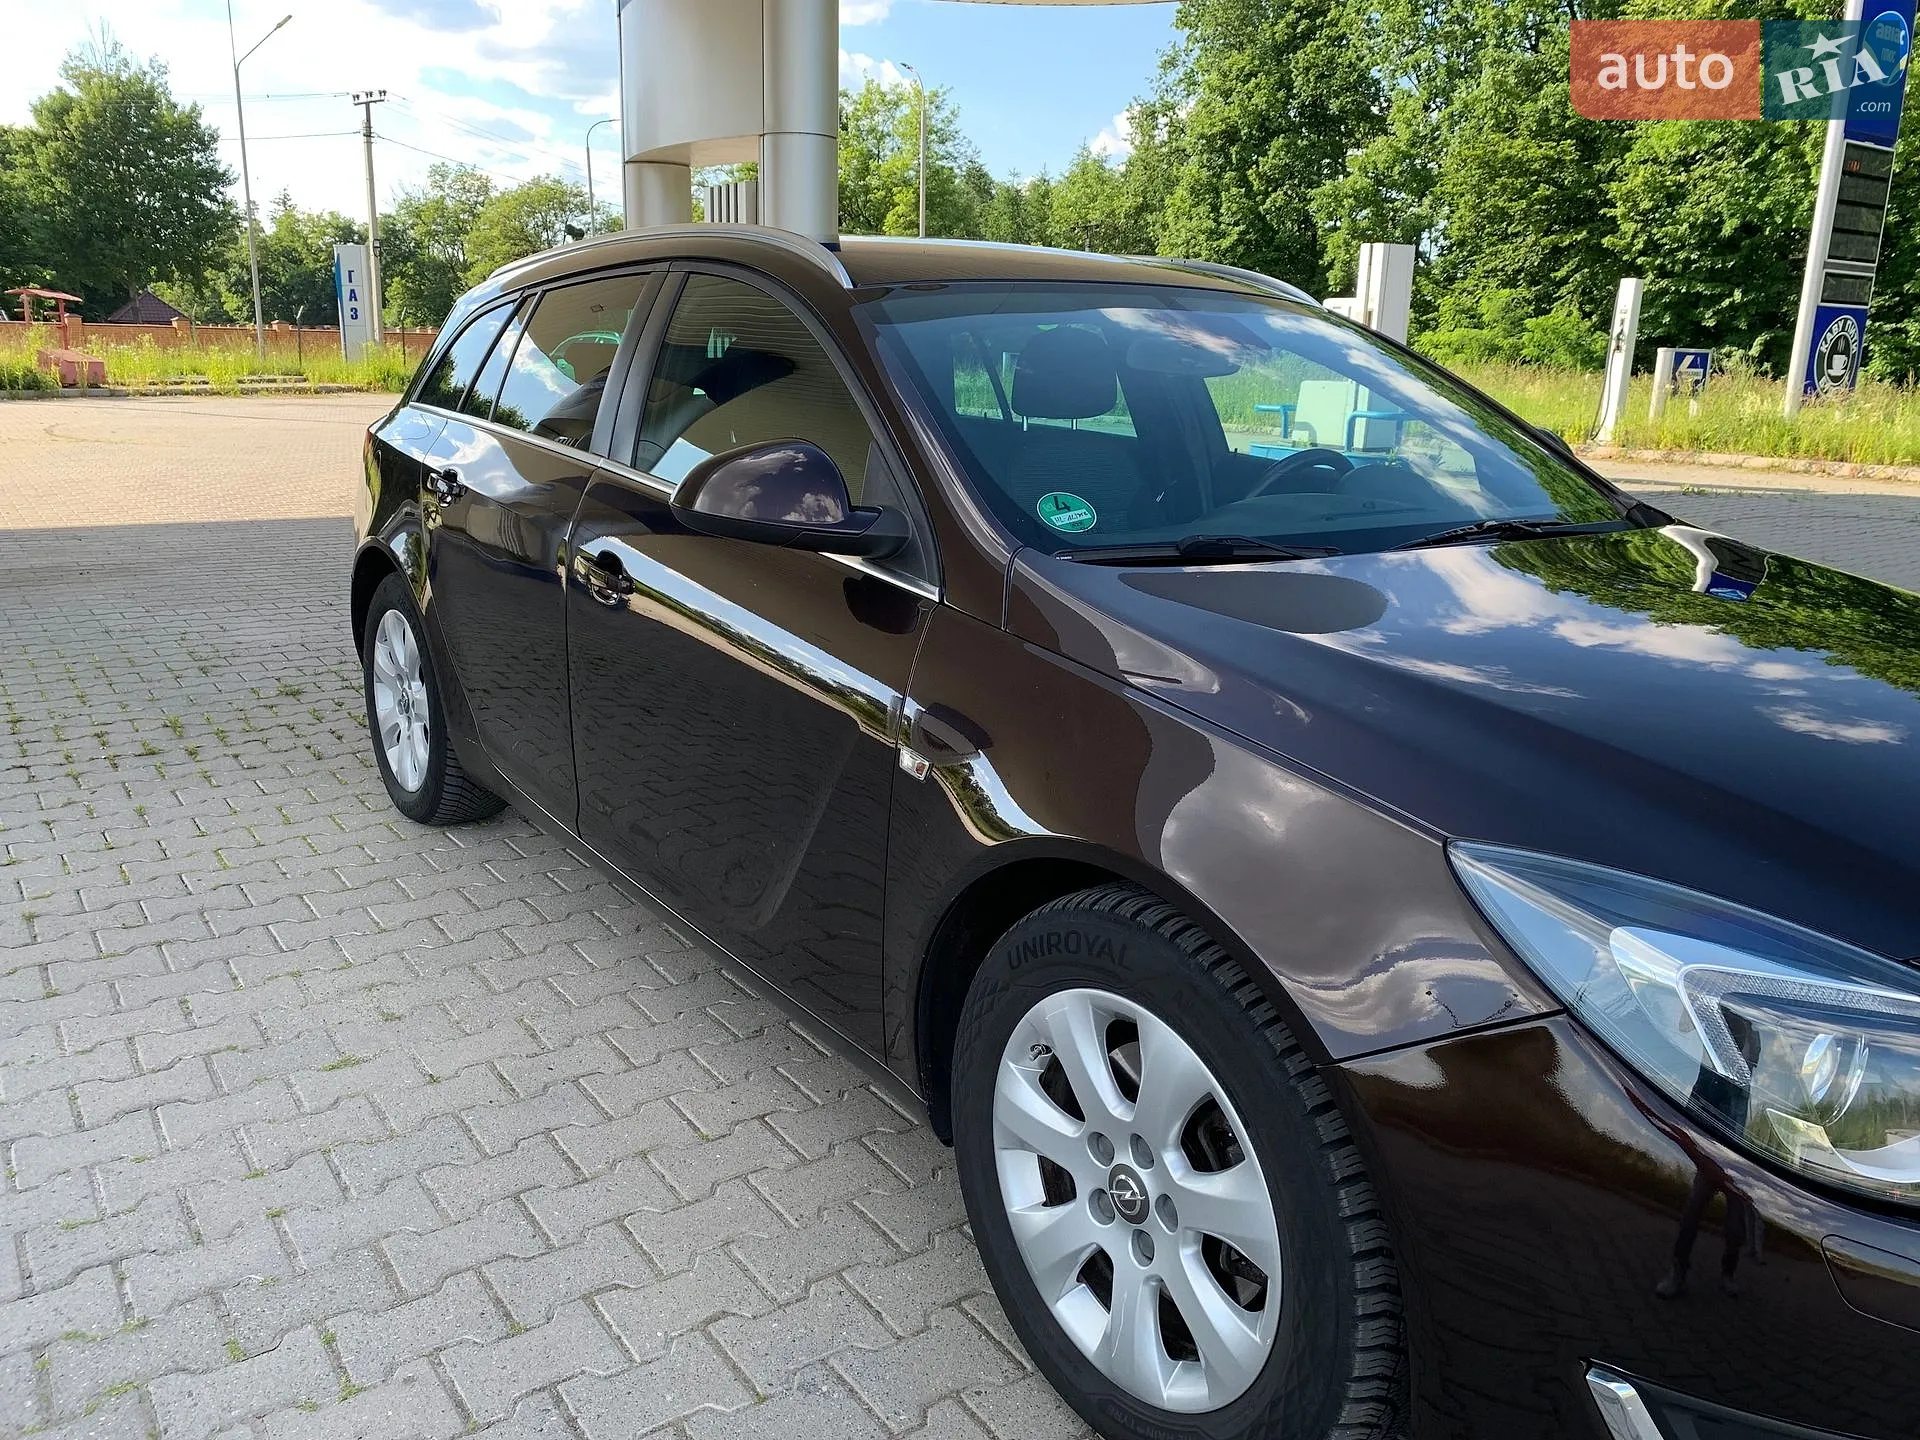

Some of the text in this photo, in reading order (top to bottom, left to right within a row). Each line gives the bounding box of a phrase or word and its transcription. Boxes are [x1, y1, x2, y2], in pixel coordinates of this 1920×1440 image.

[347, 269, 359, 321] ГАЗ
[1820, 319, 1845, 353] КАВУ
[1053, 495, 1071, 512] 4
[1007, 929, 1134, 972] UNIROYAL
